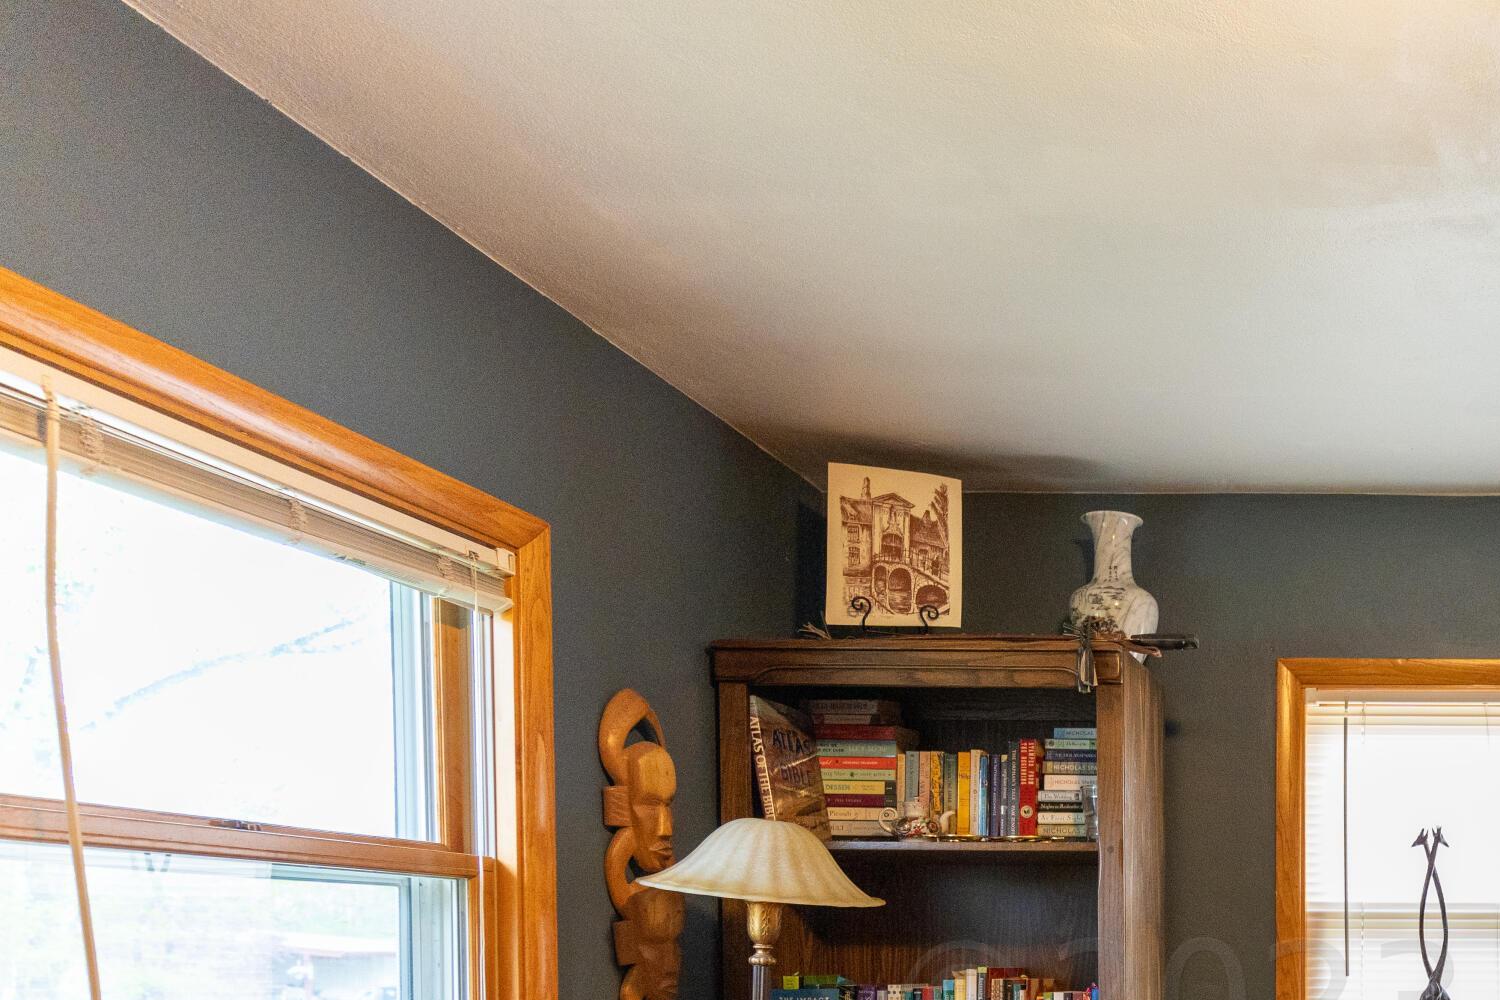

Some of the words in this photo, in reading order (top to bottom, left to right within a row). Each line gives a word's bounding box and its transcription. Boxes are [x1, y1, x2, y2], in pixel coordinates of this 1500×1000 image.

[750, 716, 764, 753] ATLAS
[756, 754, 767, 771] OF
[758, 772, 770, 794] THE
